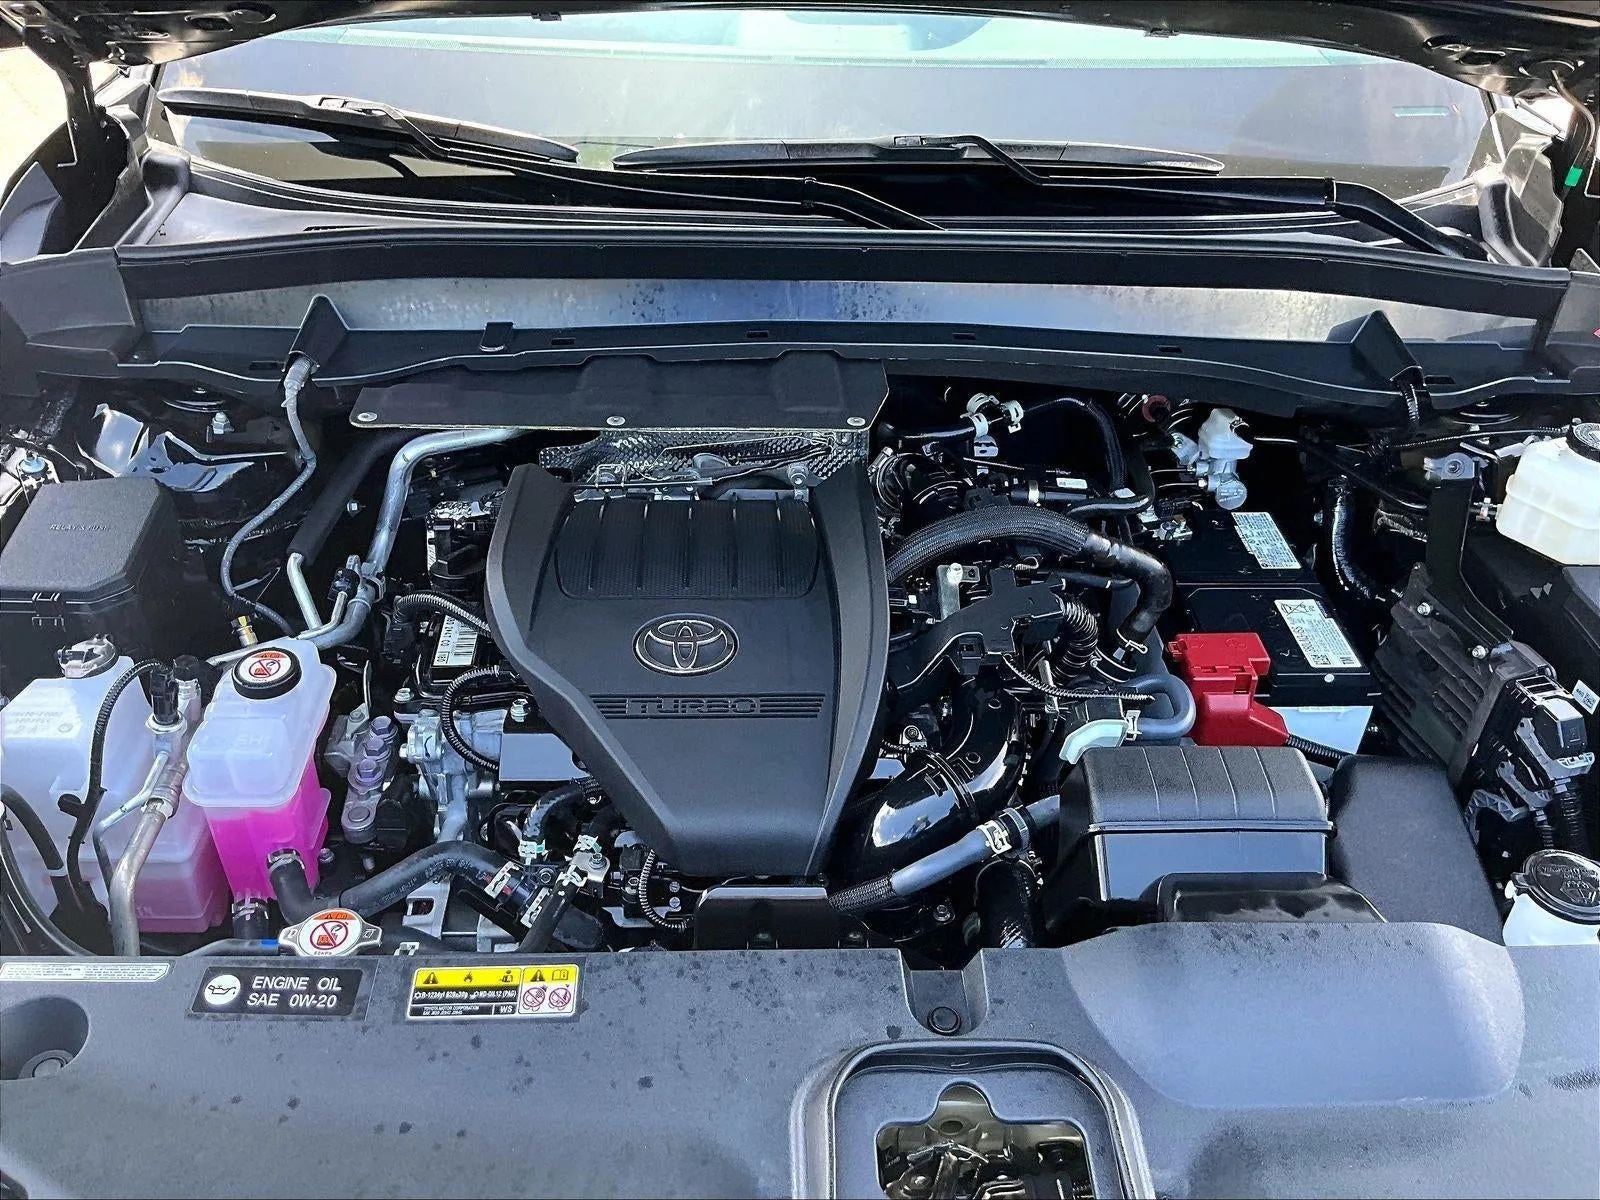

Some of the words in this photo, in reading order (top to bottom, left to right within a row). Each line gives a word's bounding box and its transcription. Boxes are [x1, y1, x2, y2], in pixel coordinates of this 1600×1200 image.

[626, 697, 760, 713] TURBO
[252, 976, 309, 990] ENGINE
[317, 977, 342, 991] OIL
[247, 993, 280, 1006] SAE
[288, 994, 337, 1008] 0W-20
[500, 1005, 513, 1013] WS
